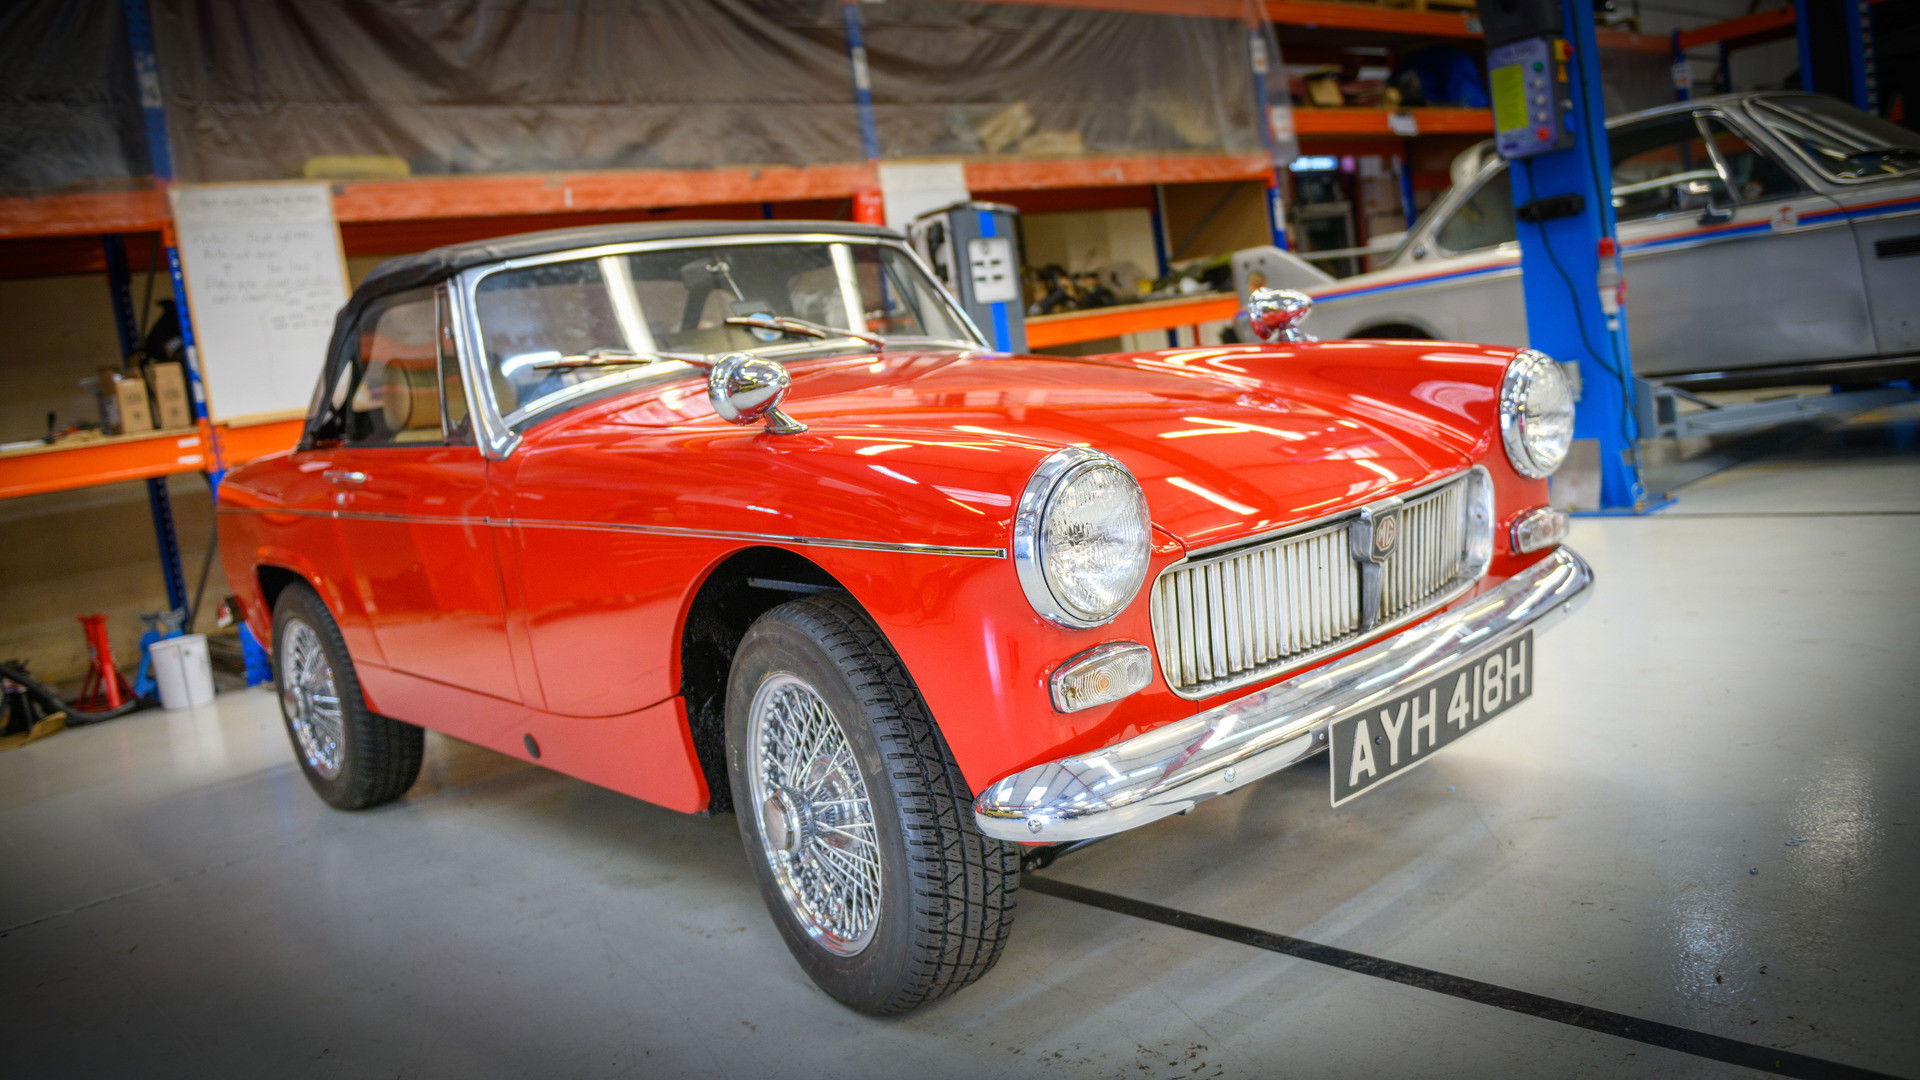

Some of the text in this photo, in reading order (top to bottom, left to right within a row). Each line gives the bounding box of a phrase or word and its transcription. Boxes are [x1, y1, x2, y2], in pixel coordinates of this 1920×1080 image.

[1377, 516, 1395, 549] MG
[1350, 639, 1526, 787] AYH 418H
